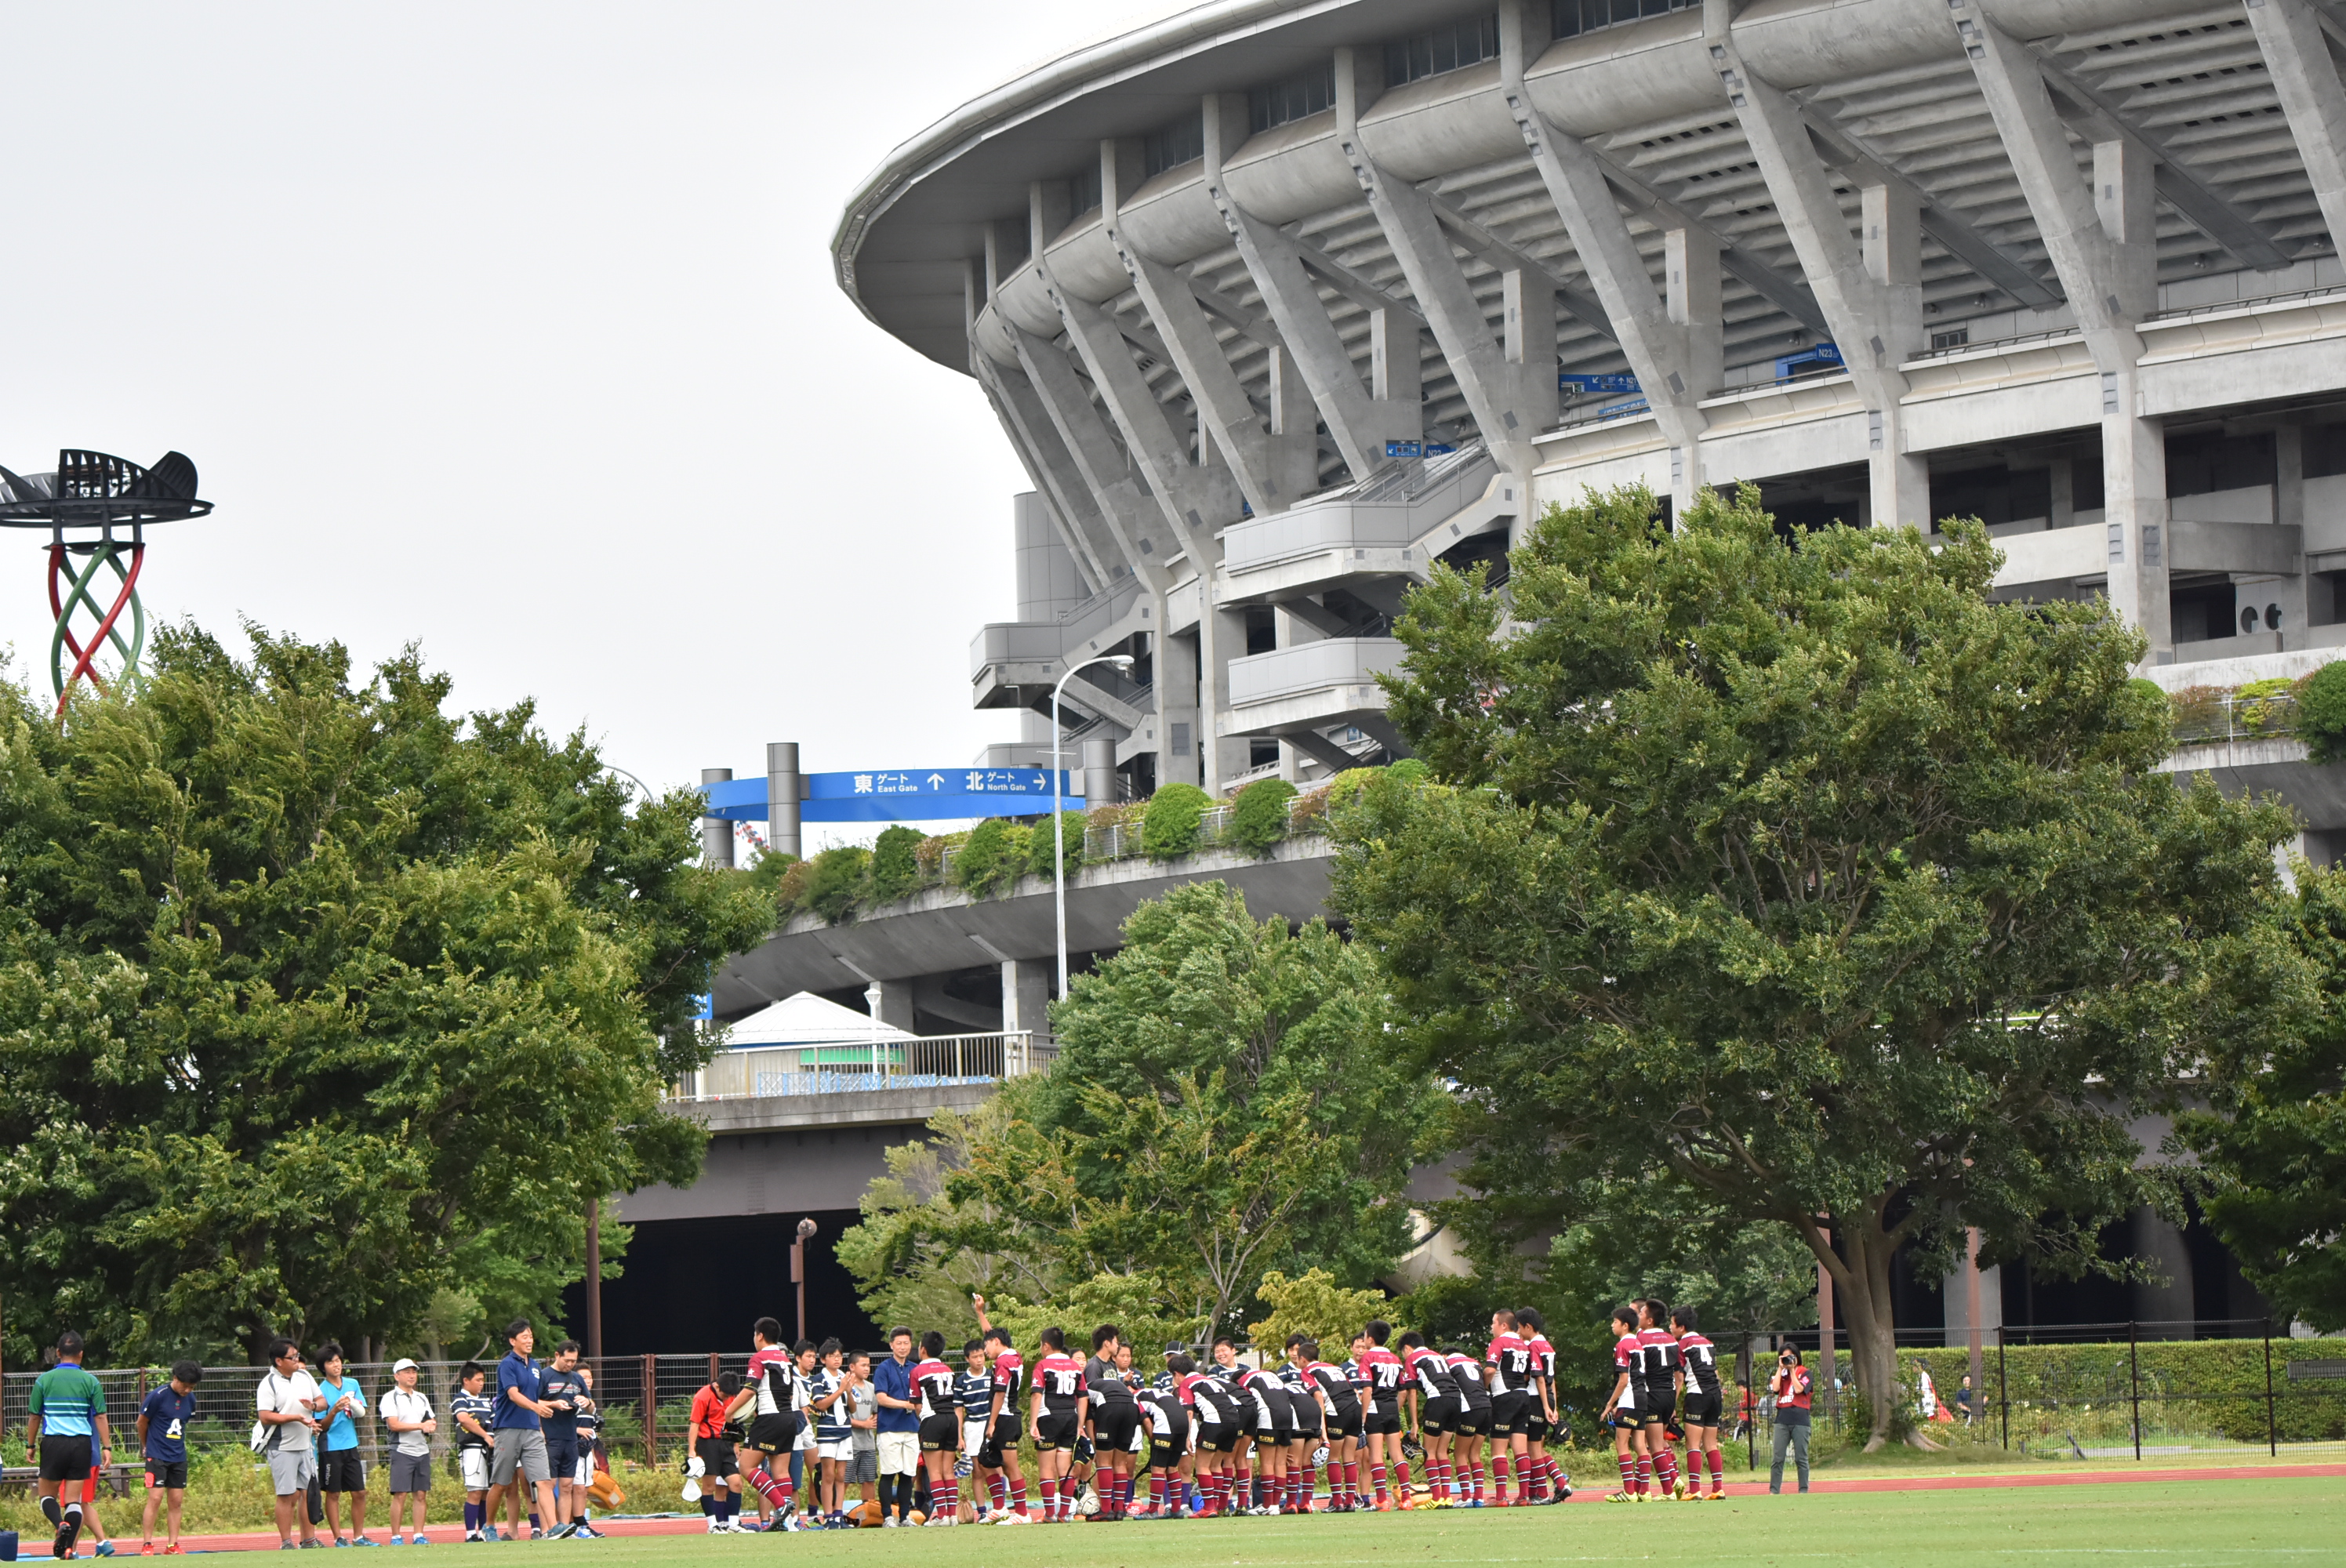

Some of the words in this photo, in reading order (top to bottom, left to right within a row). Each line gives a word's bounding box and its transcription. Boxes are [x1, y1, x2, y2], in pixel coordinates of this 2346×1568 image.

[1818, 348, 1832, 358] N23
[1428, 1356, 1451, 1374] 11
[1512, 1351, 1528, 1374] 13
[1658, 1344, 1668, 1366] 1
[1699, 1345, 1712, 1366] 4
[780, 1361, 791, 1385] 3
[1257, 1372, 1284, 1390] 19
[1377, 1363, 1400, 1388] 20
[1462, 1361, 1480, 1381] 6
[932, 1372, 954, 1396] 12
[1054, 1370, 1077, 1395] 16
